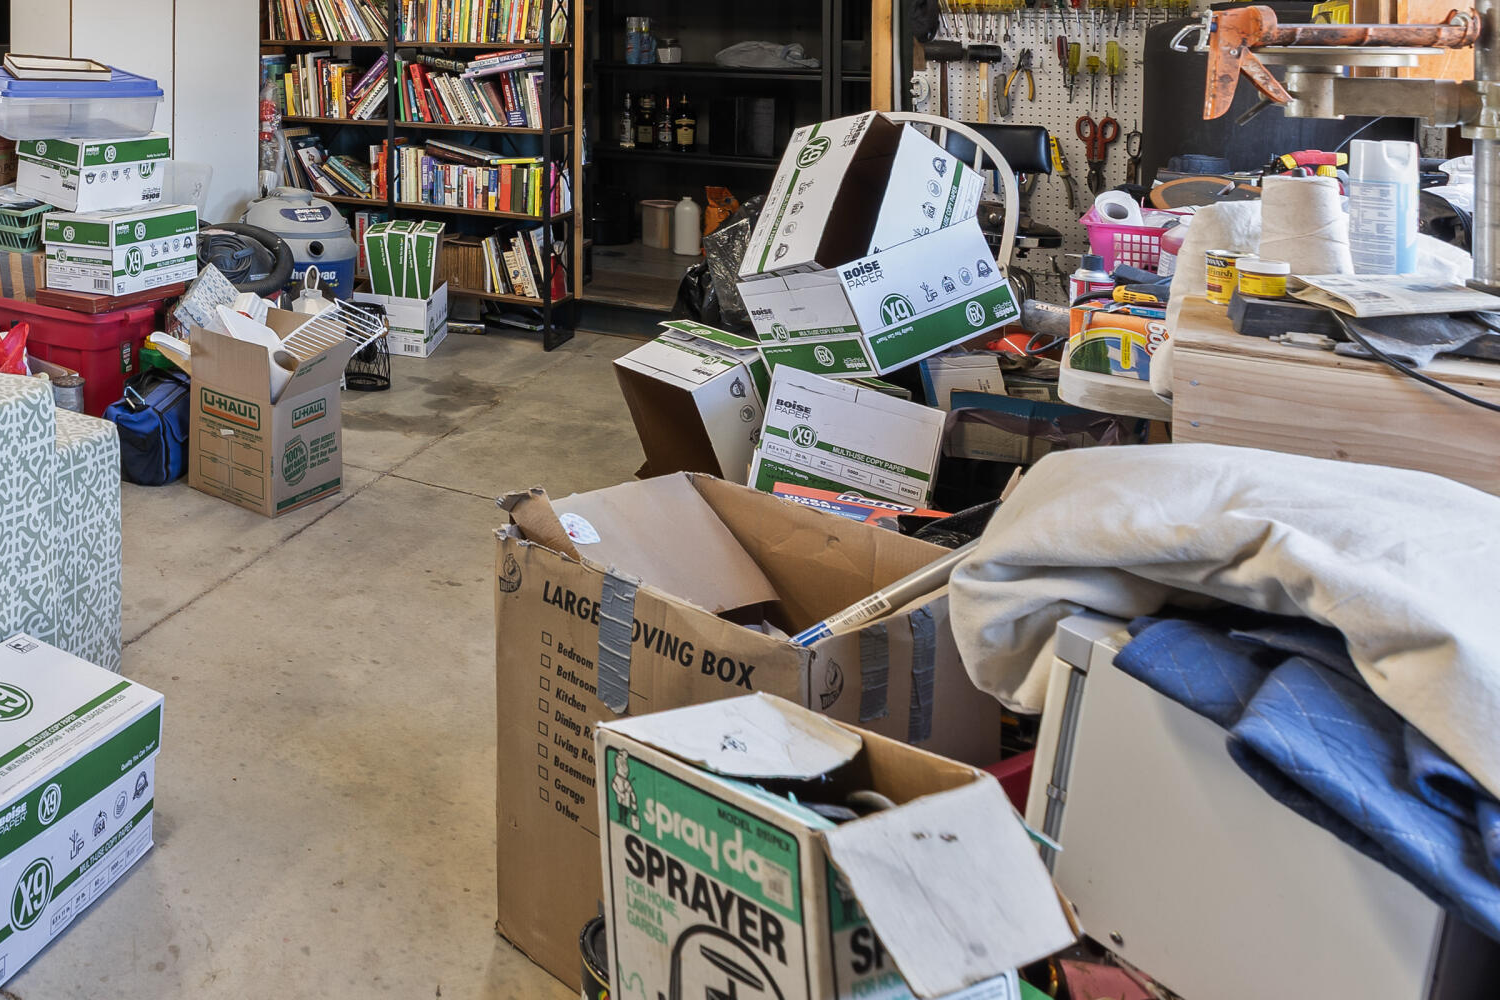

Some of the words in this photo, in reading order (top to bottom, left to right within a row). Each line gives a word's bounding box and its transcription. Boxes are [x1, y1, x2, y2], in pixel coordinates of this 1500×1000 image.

[847, 271, 885, 291] PAPER
[204, 391, 257, 420] U-HAUL
[294, 402, 324, 421] U-HAUL
[775, 405, 811, 421] PAPER
[284, 446, 305, 462] 100%
[832, 446, 865, 463] MULTI-USE
[865, 456, 884, 467] COPY
[884, 461, 906, 475] PAPER
[500, 575, 518, 593] DUCK
[543, 580, 600, 626] LARGE
[631, 619, 694, 668] OVING
[701, 649, 757, 691] BOX
[557, 642, 594, 671] Bedroom
[556, 664, 597, 696] Bathroom
[555, 688, 587, 713] Kitchen
[554, 710, 582, 738] Dining
[6, 753, 33, 774] MULTIUSO
[31, 744, 45, 759] PARA
[43, 733, 64, 750] COPIAS
[554, 733, 579, 761] Living
[553, 756, 596, 789] Basement
[554, 779, 586, 807] Garage
[555, 800, 580, 823] Other
[717, 807, 753, 833] MODEL
[94, 820, 107, 837] USA
[643, 798, 720, 873] spray
[79, 849, 107, 876] MULTI-USE
[104, 836, 119, 857] COPY
[116, 820, 134, 845] PAPER
[624, 834, 788, 967] SPRAYER
[625, 875, 647, 899] FOR
[626, 893, 655, 924] LAWN
[654, 912, 663, 927] &
[626, 909, 668, 947] GARDEN
